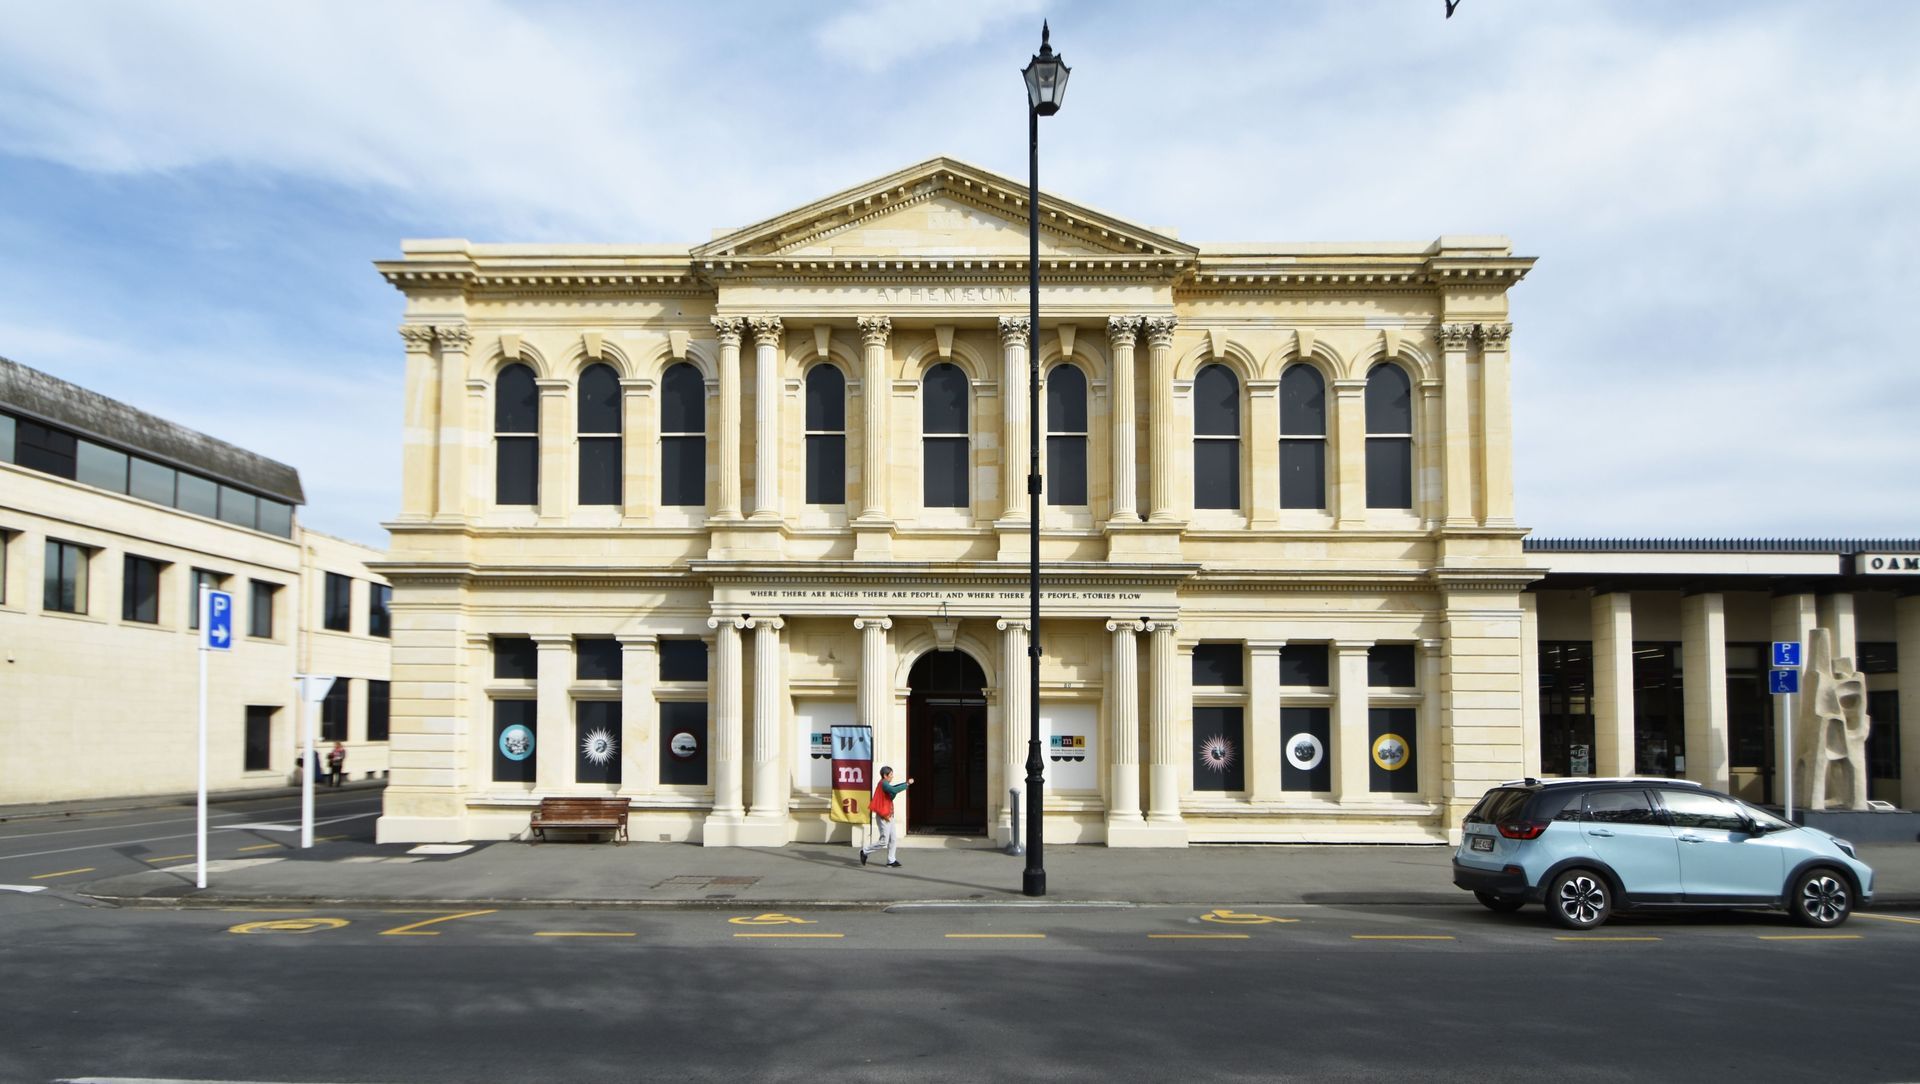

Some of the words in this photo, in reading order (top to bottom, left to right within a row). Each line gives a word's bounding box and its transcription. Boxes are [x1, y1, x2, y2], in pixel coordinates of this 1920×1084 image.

[214, 597, 228, 617] P
[1782, 643, 1792, 653] P
[1784, 653, 1790, 661] 5
[1780, 671, 1788, 680] P
